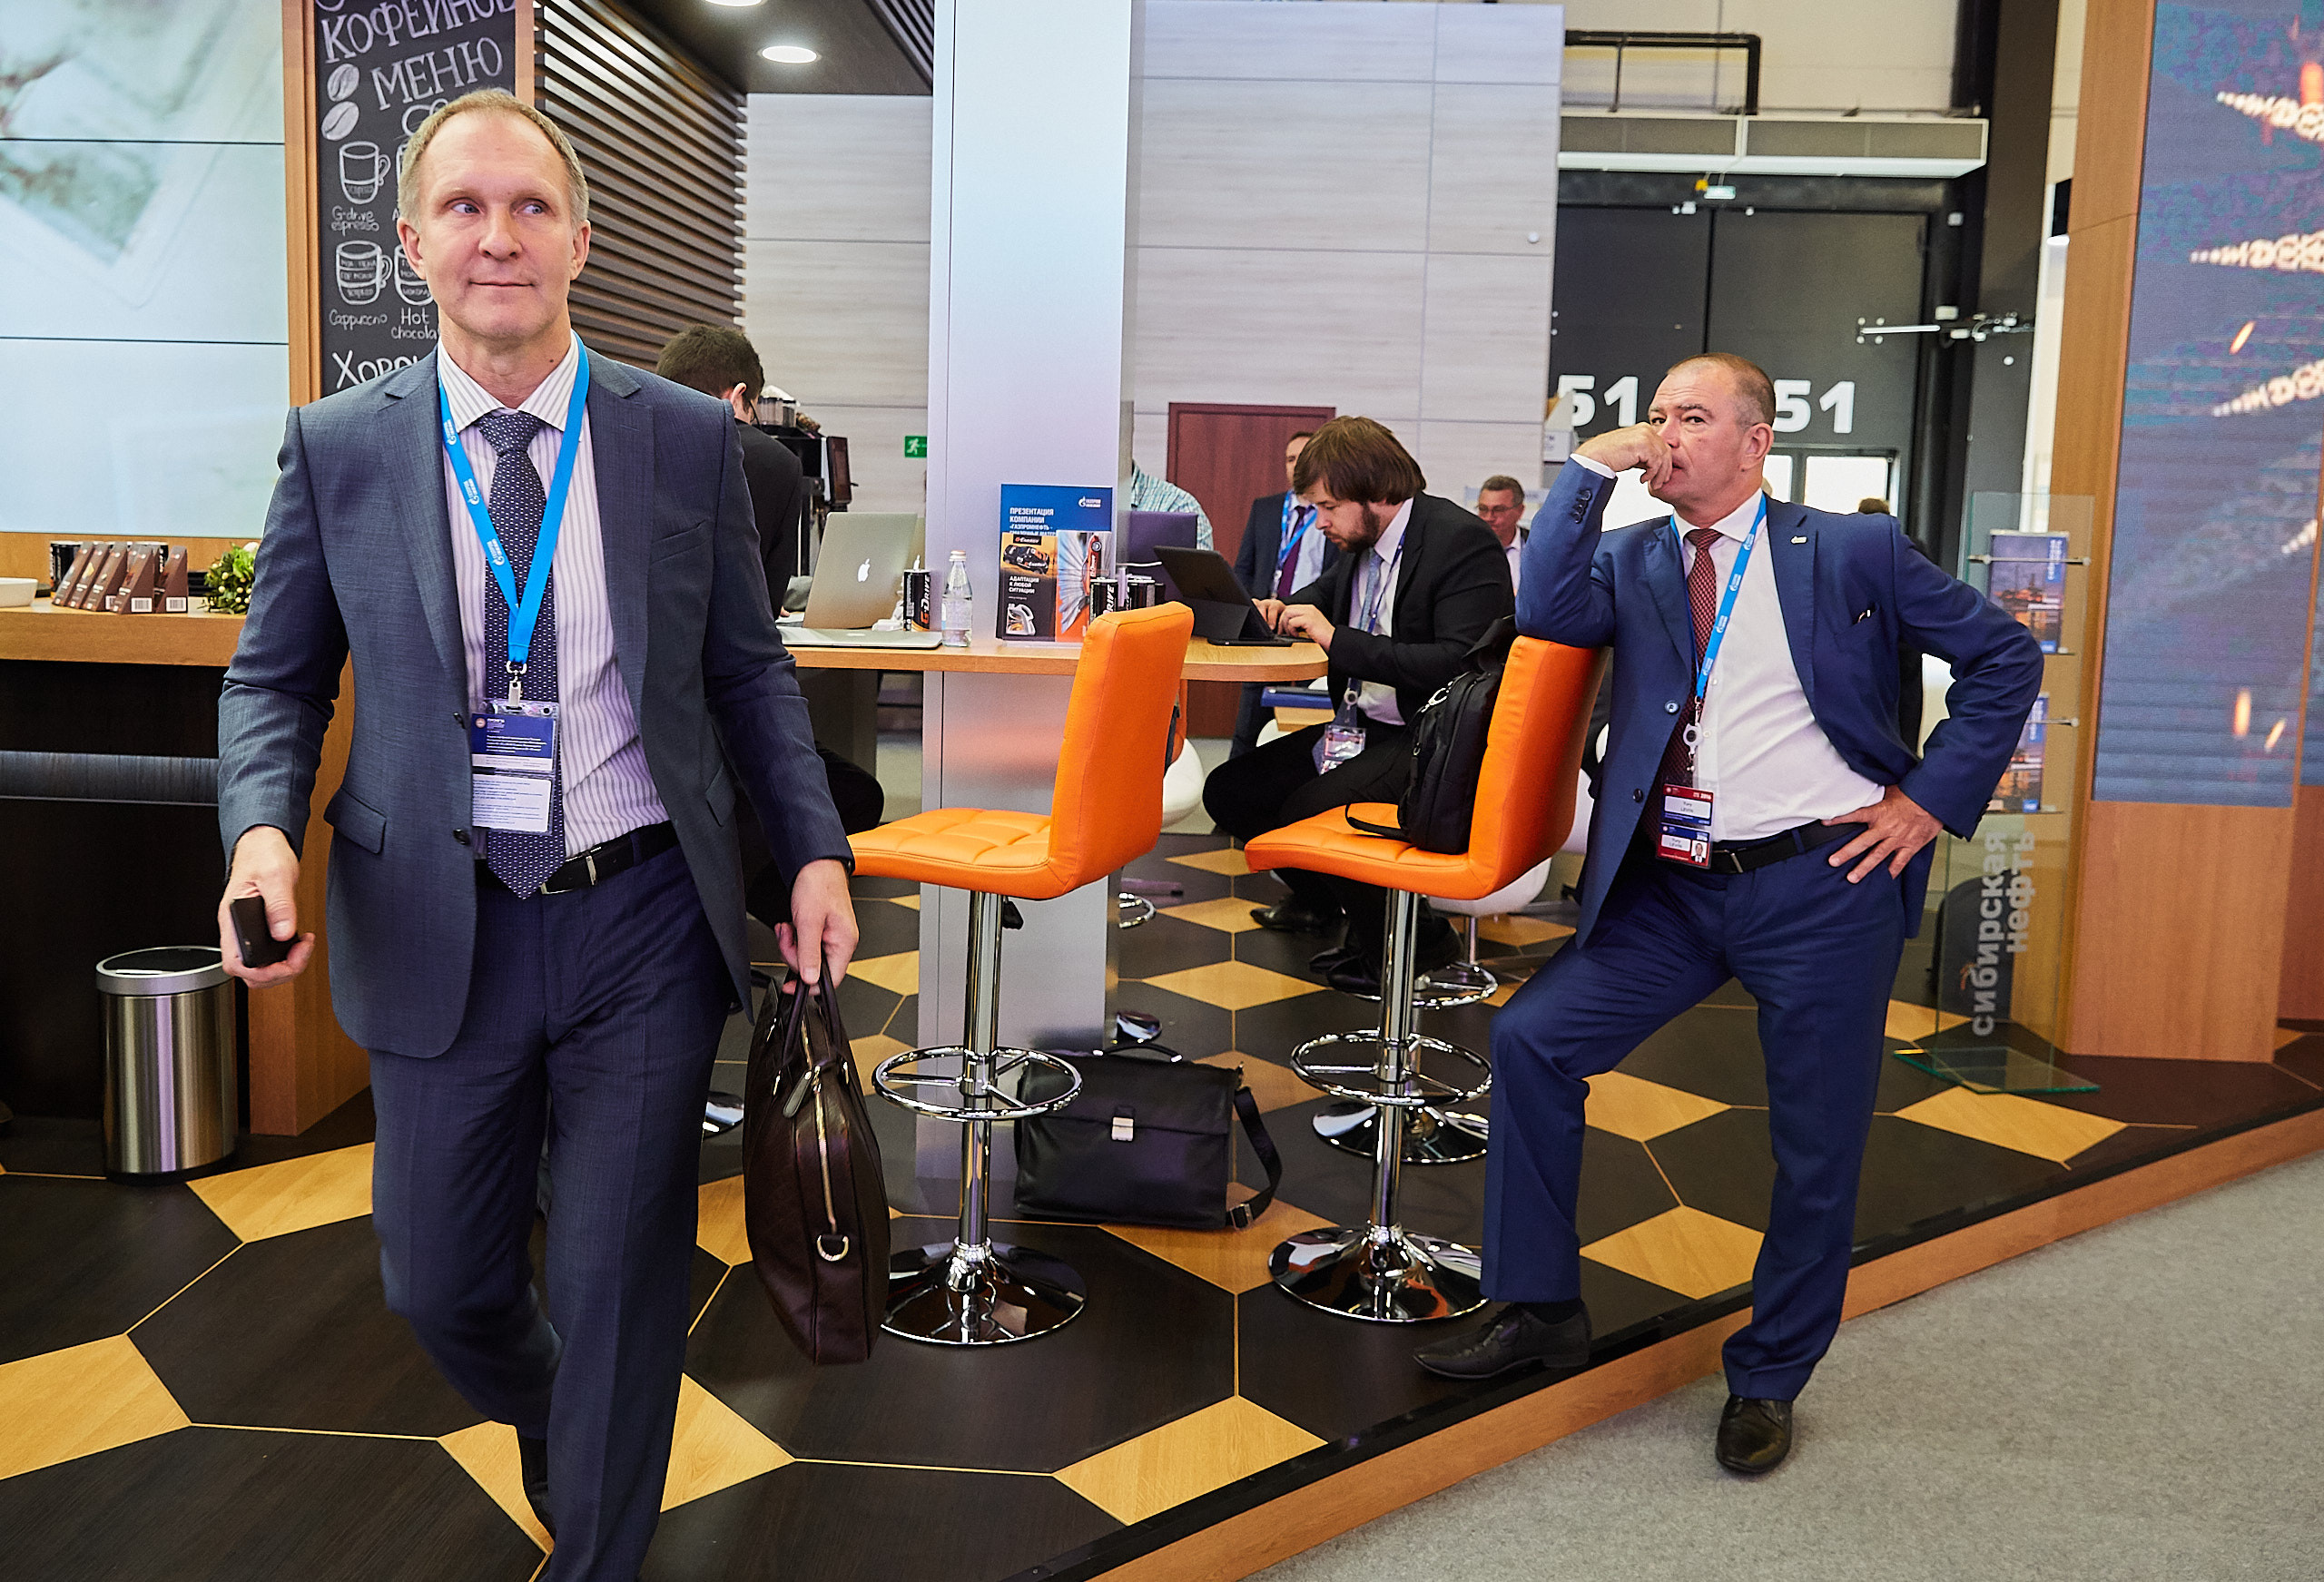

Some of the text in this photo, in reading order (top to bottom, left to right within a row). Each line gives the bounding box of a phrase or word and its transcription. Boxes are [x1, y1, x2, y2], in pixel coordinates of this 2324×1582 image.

[370, 37, 503, 111] МЕНЮ
[401, 307, 429, 326] Hot
[390, 324, 438, 339] chocola
[1558, 375, 1639, 427] 51
[1772, 379, 1856, 435] 51
[1009, 507, 1054, 516] ПРЕЗЕНТАЦИЯ
[1009, 516, 1045, 524] КОМПАНИИ
[1009, 575, 1039, 584] АДАПТАЦИЯ
[1104, 585, 1115, 614] RIVE
[2006, 830, 2035, 953] нефть
[1971, 831, 2008, 1037] сибирская
